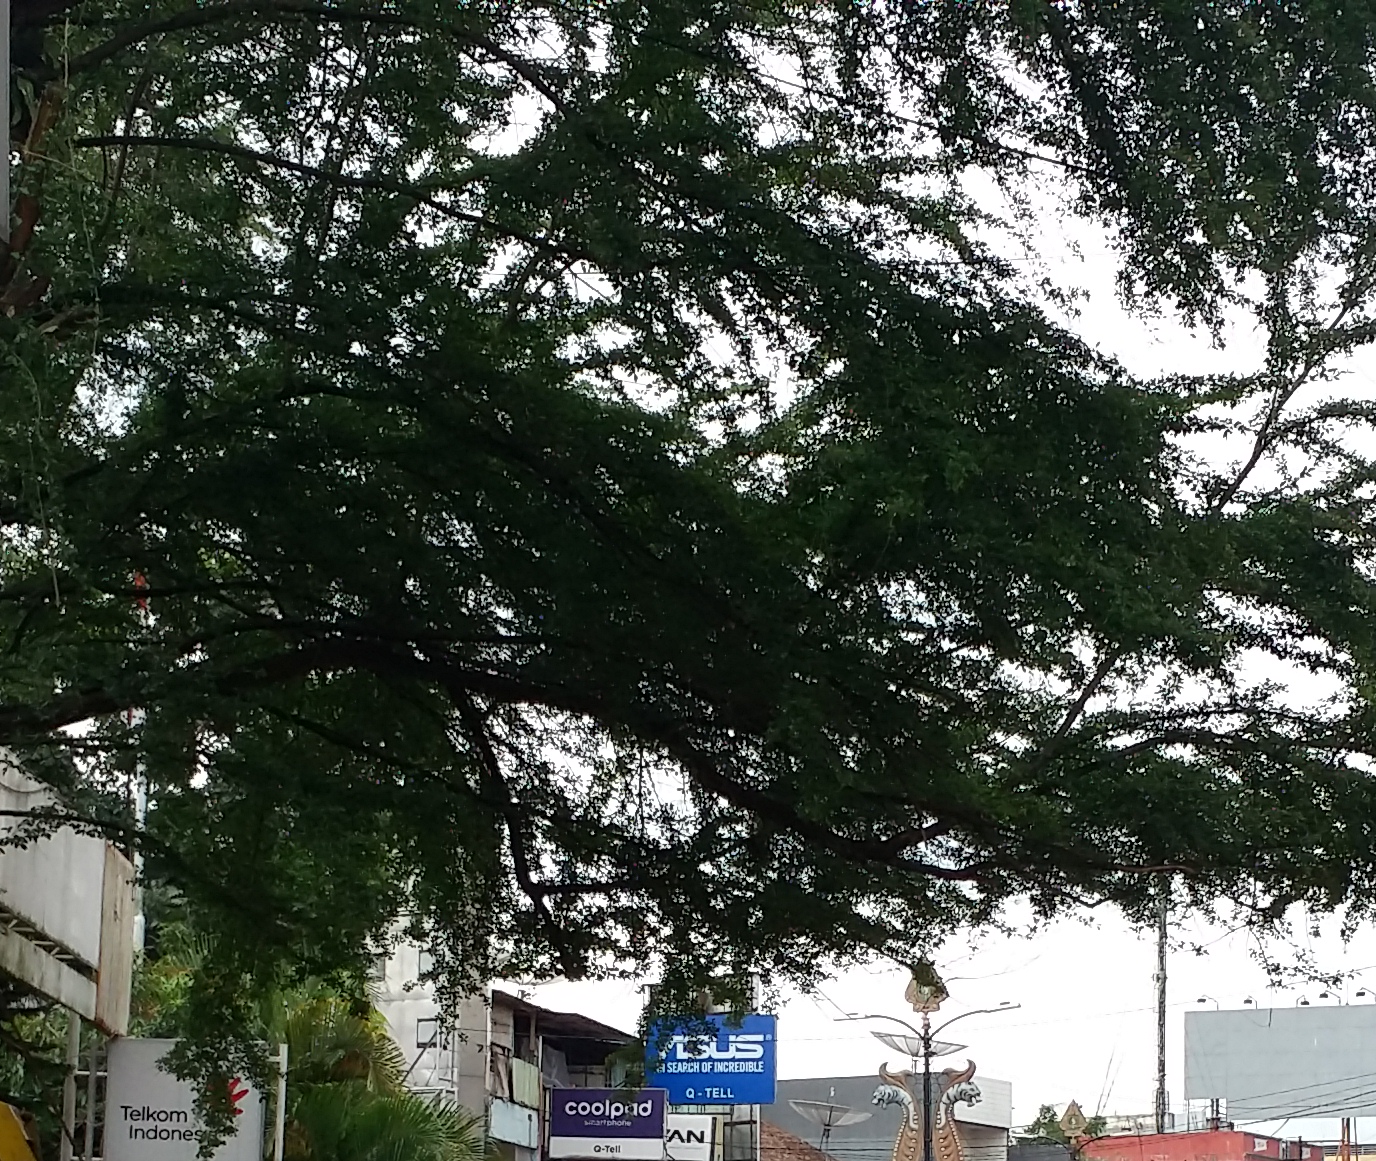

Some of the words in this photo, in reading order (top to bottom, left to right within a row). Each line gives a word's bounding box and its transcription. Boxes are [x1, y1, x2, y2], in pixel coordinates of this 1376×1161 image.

[667, 1062, 700, 1073] SEARCH
[701, 1062, 712, 1073] OF
[713, 1061, 765, 1073] INCREDIBLE
[686, 1087, 695, 1099] Q
[704, 1088, 735, 1099] TELL
[120, 1104, 189, 1123] Telkom
[564, 1099, 654, 1119] coolpad
[128, 1124, 208, 1142] Indones
[593, 1144, 621, 1153] Q-Tell
